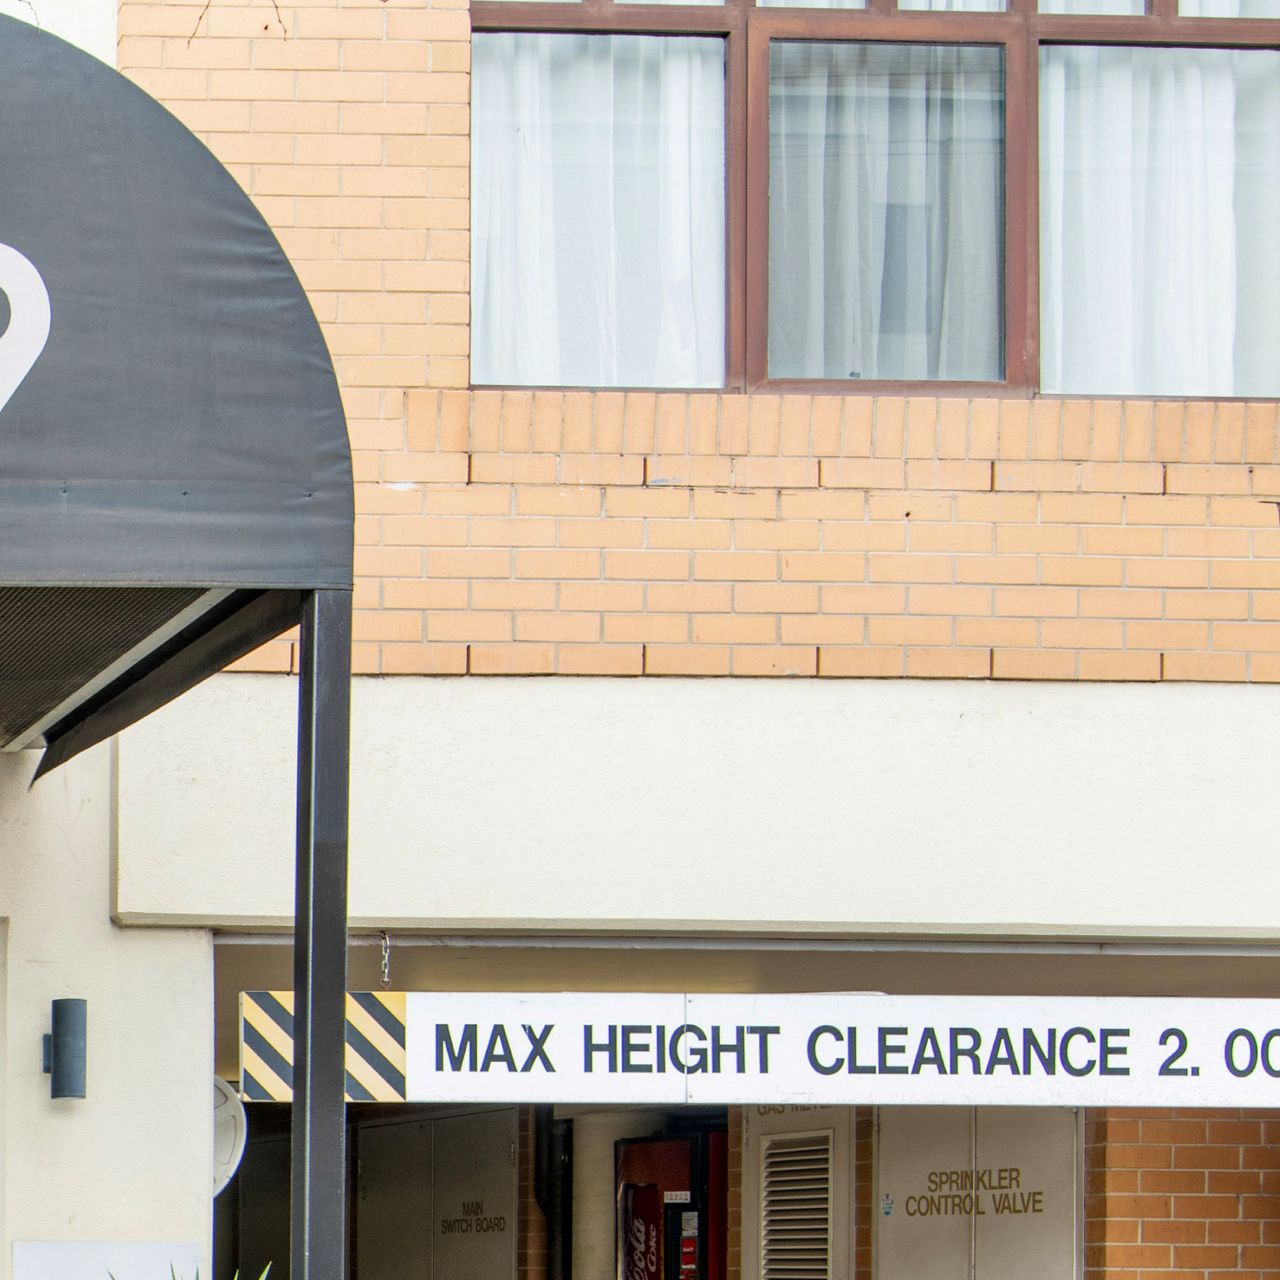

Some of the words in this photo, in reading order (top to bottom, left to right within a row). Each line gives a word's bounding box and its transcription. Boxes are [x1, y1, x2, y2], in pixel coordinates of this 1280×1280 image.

[435, 1023, 557, 1073] MAX
[583, 1024, 781, 1075] HEIGHT
[806, 1024, 1130, 1077] CLEARANCE
[1157, 1027, 1201, 1077] 2.
[927, 1167, 1021, 1193] SPRINKLER
[462, 1201, 484, 1217] MAIN
[905, 1193, 986, 1217] CONTROL
[992, 1191, 1044, 1215] VALVE
[441, 1218, 473, 1235] SWITCH
[475, 1216, 506, 1233] BOARD
[647, 1222, 658, 1274] Coke
